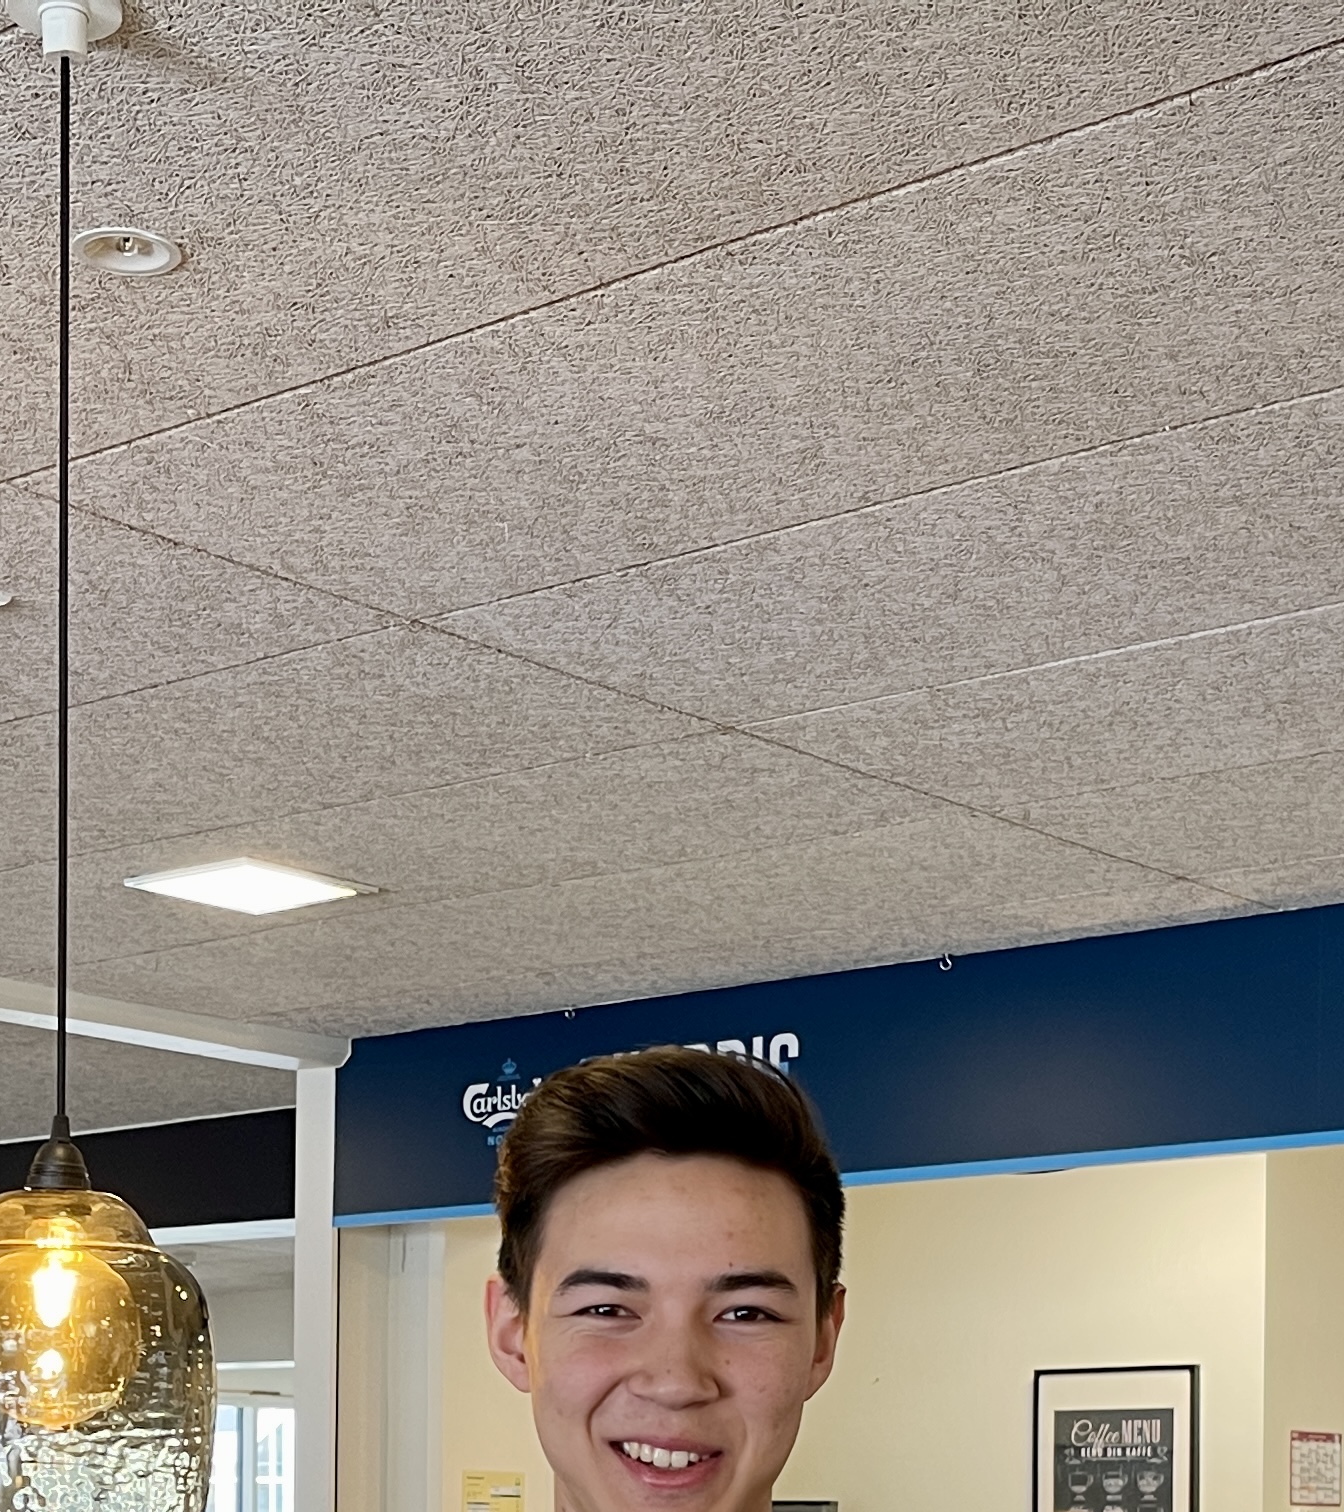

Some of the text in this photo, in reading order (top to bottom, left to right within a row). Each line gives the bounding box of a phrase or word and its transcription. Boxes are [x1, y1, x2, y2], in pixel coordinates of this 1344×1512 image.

[462, 1077, 544, 1129] Carlsb
[1071, 1418, 1161, 1449] Coffee MENU
